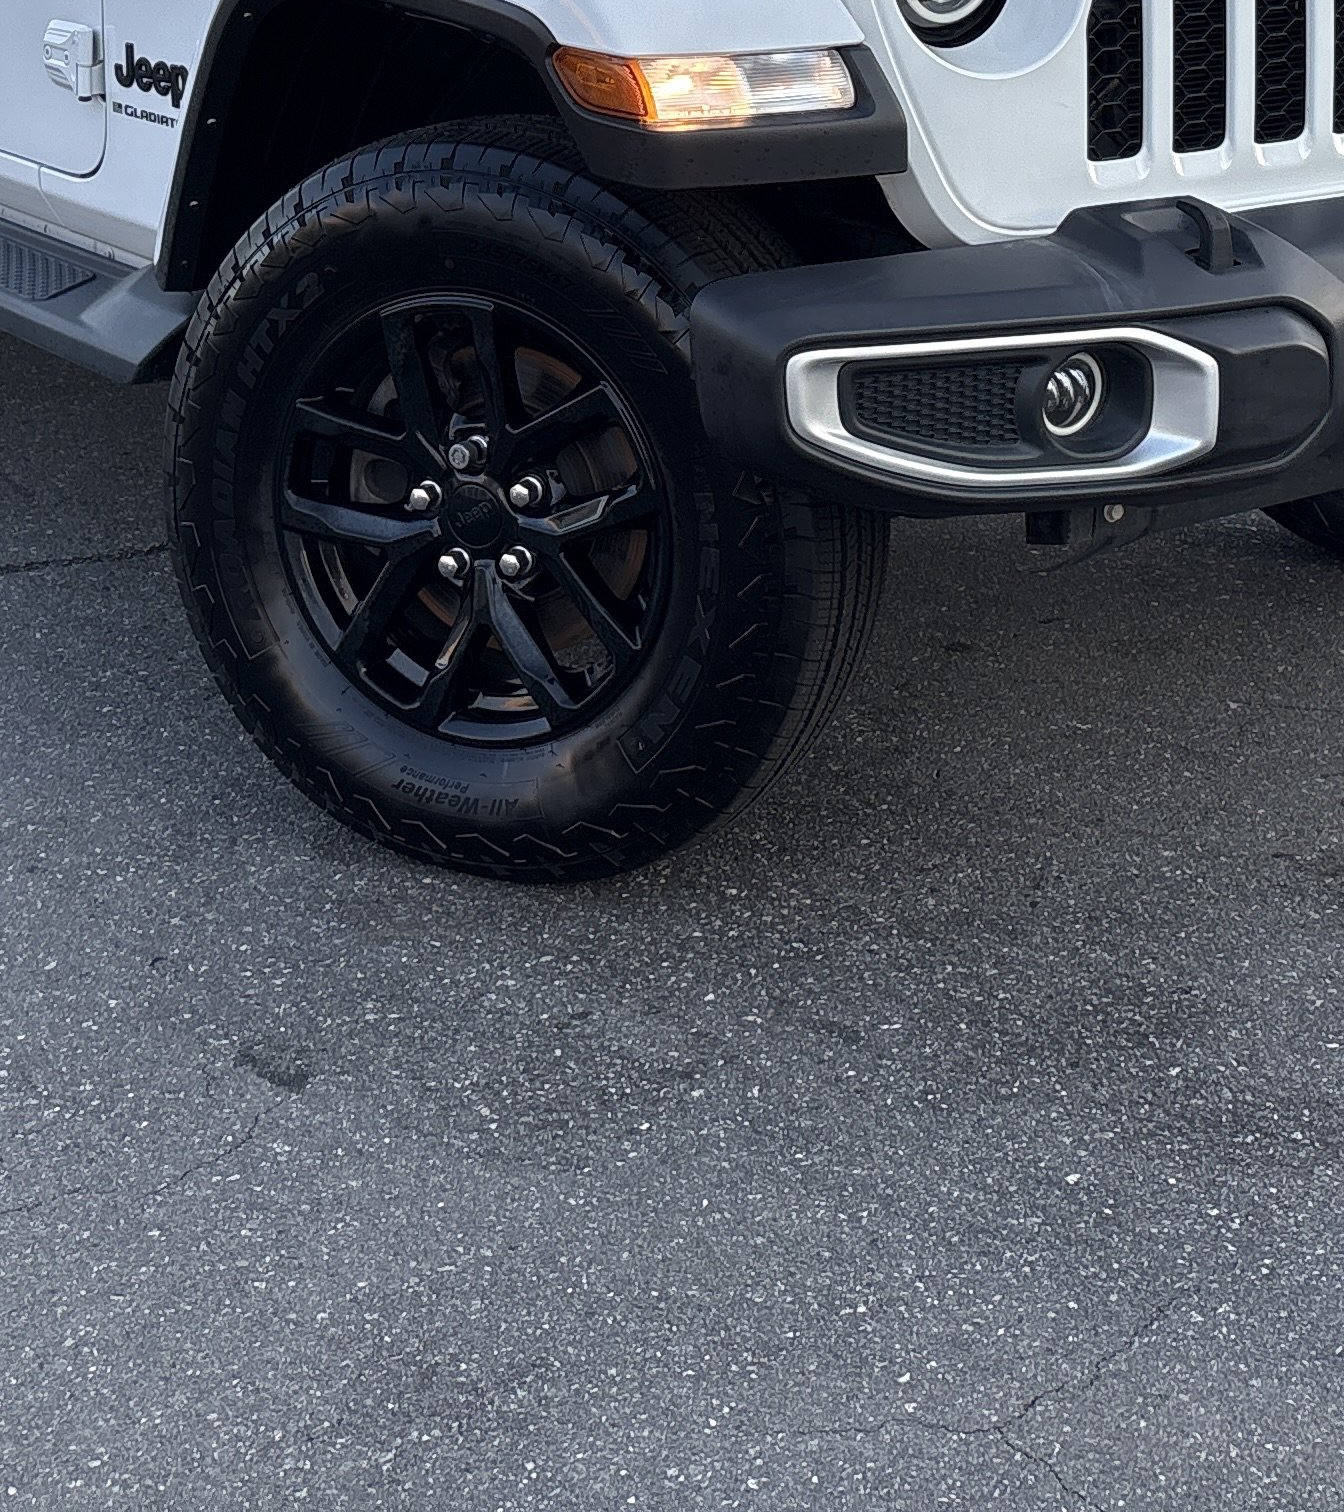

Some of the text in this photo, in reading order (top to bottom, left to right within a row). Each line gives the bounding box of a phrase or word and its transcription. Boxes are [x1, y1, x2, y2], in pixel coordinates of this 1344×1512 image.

[114, 42, 189, 109] Jeep
[124, 104, 178, 128] GLADIAT
[455, 501, 493, 528] Jeep
[400, 765, 471, 794] Performance
[391, 778, 520, 817] All-Weather
